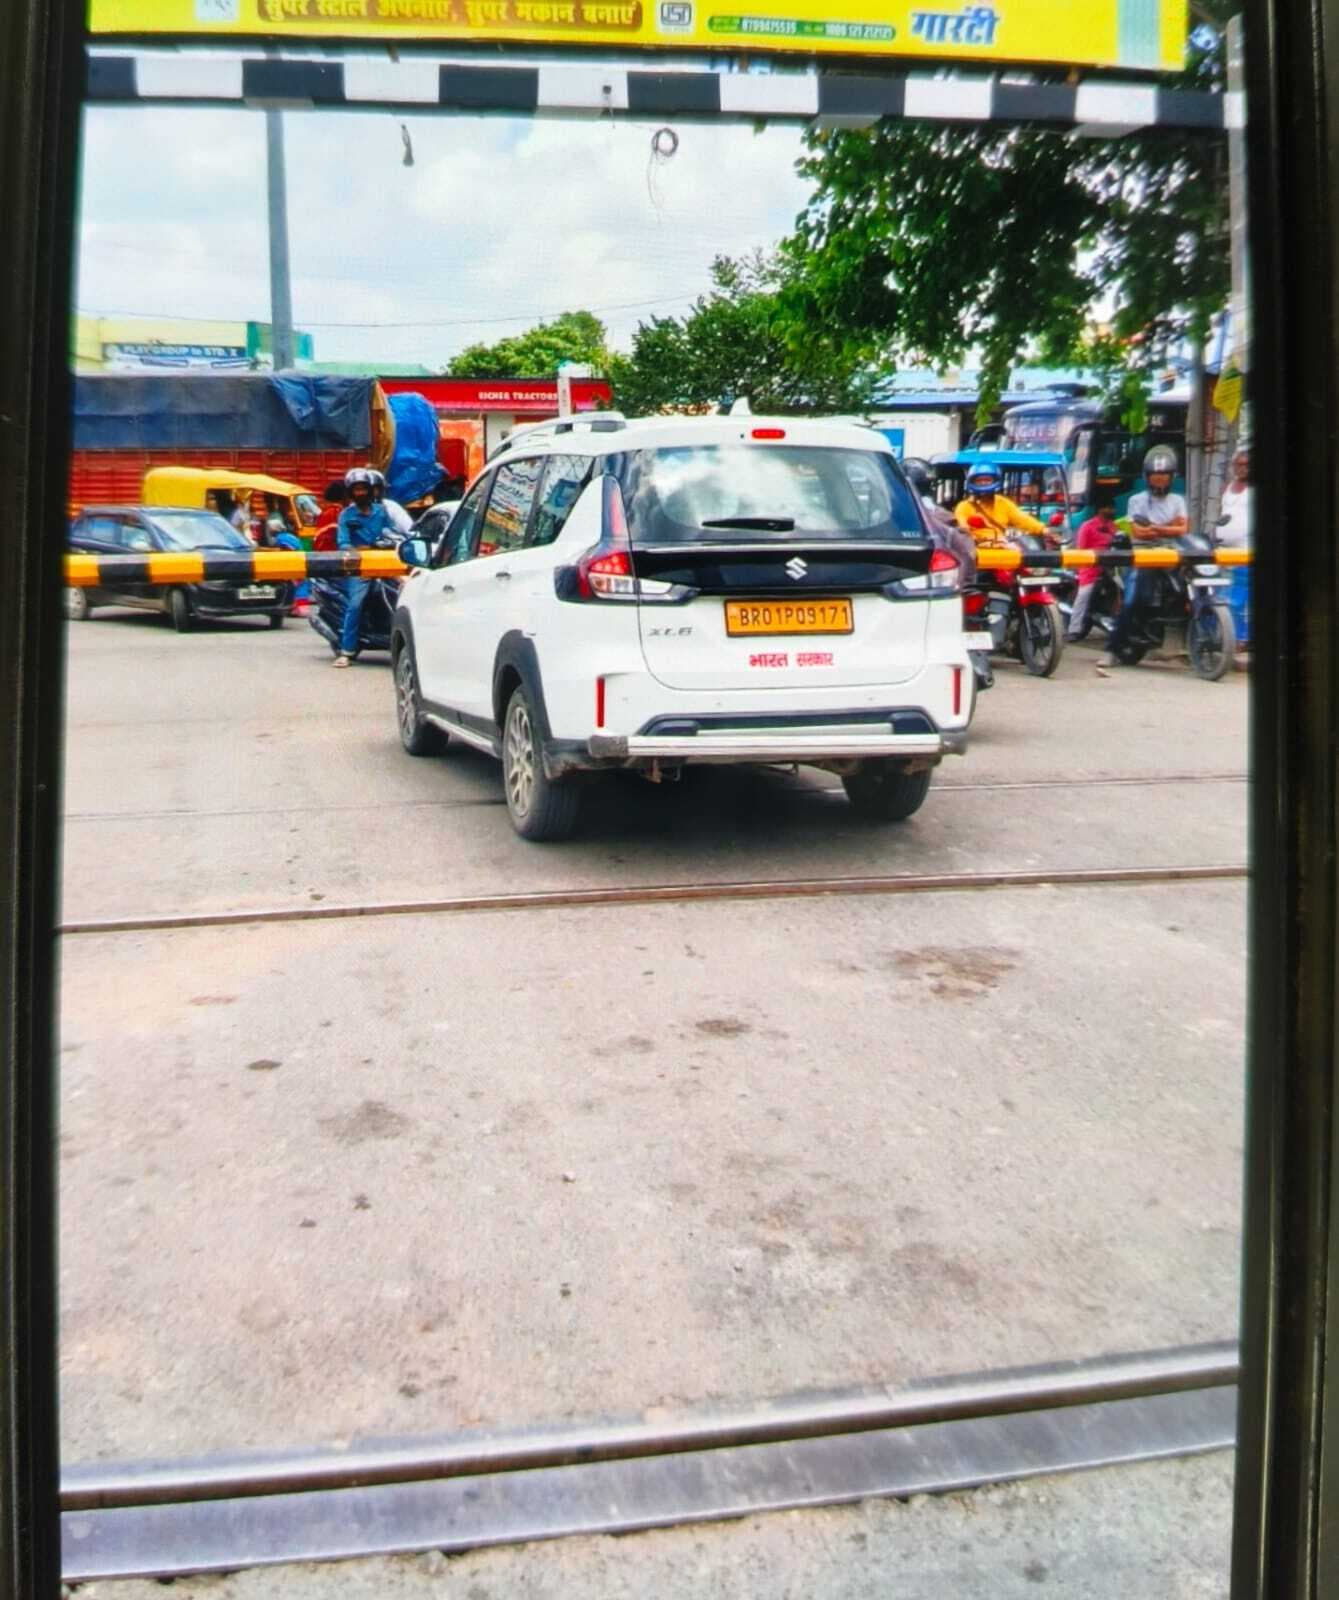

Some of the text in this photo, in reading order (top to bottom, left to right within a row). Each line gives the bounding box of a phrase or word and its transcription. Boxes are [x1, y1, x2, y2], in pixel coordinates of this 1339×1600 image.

[911, 7, 999, 45] गारंटी
[748, 652, 834, 667] भारत सरकार
